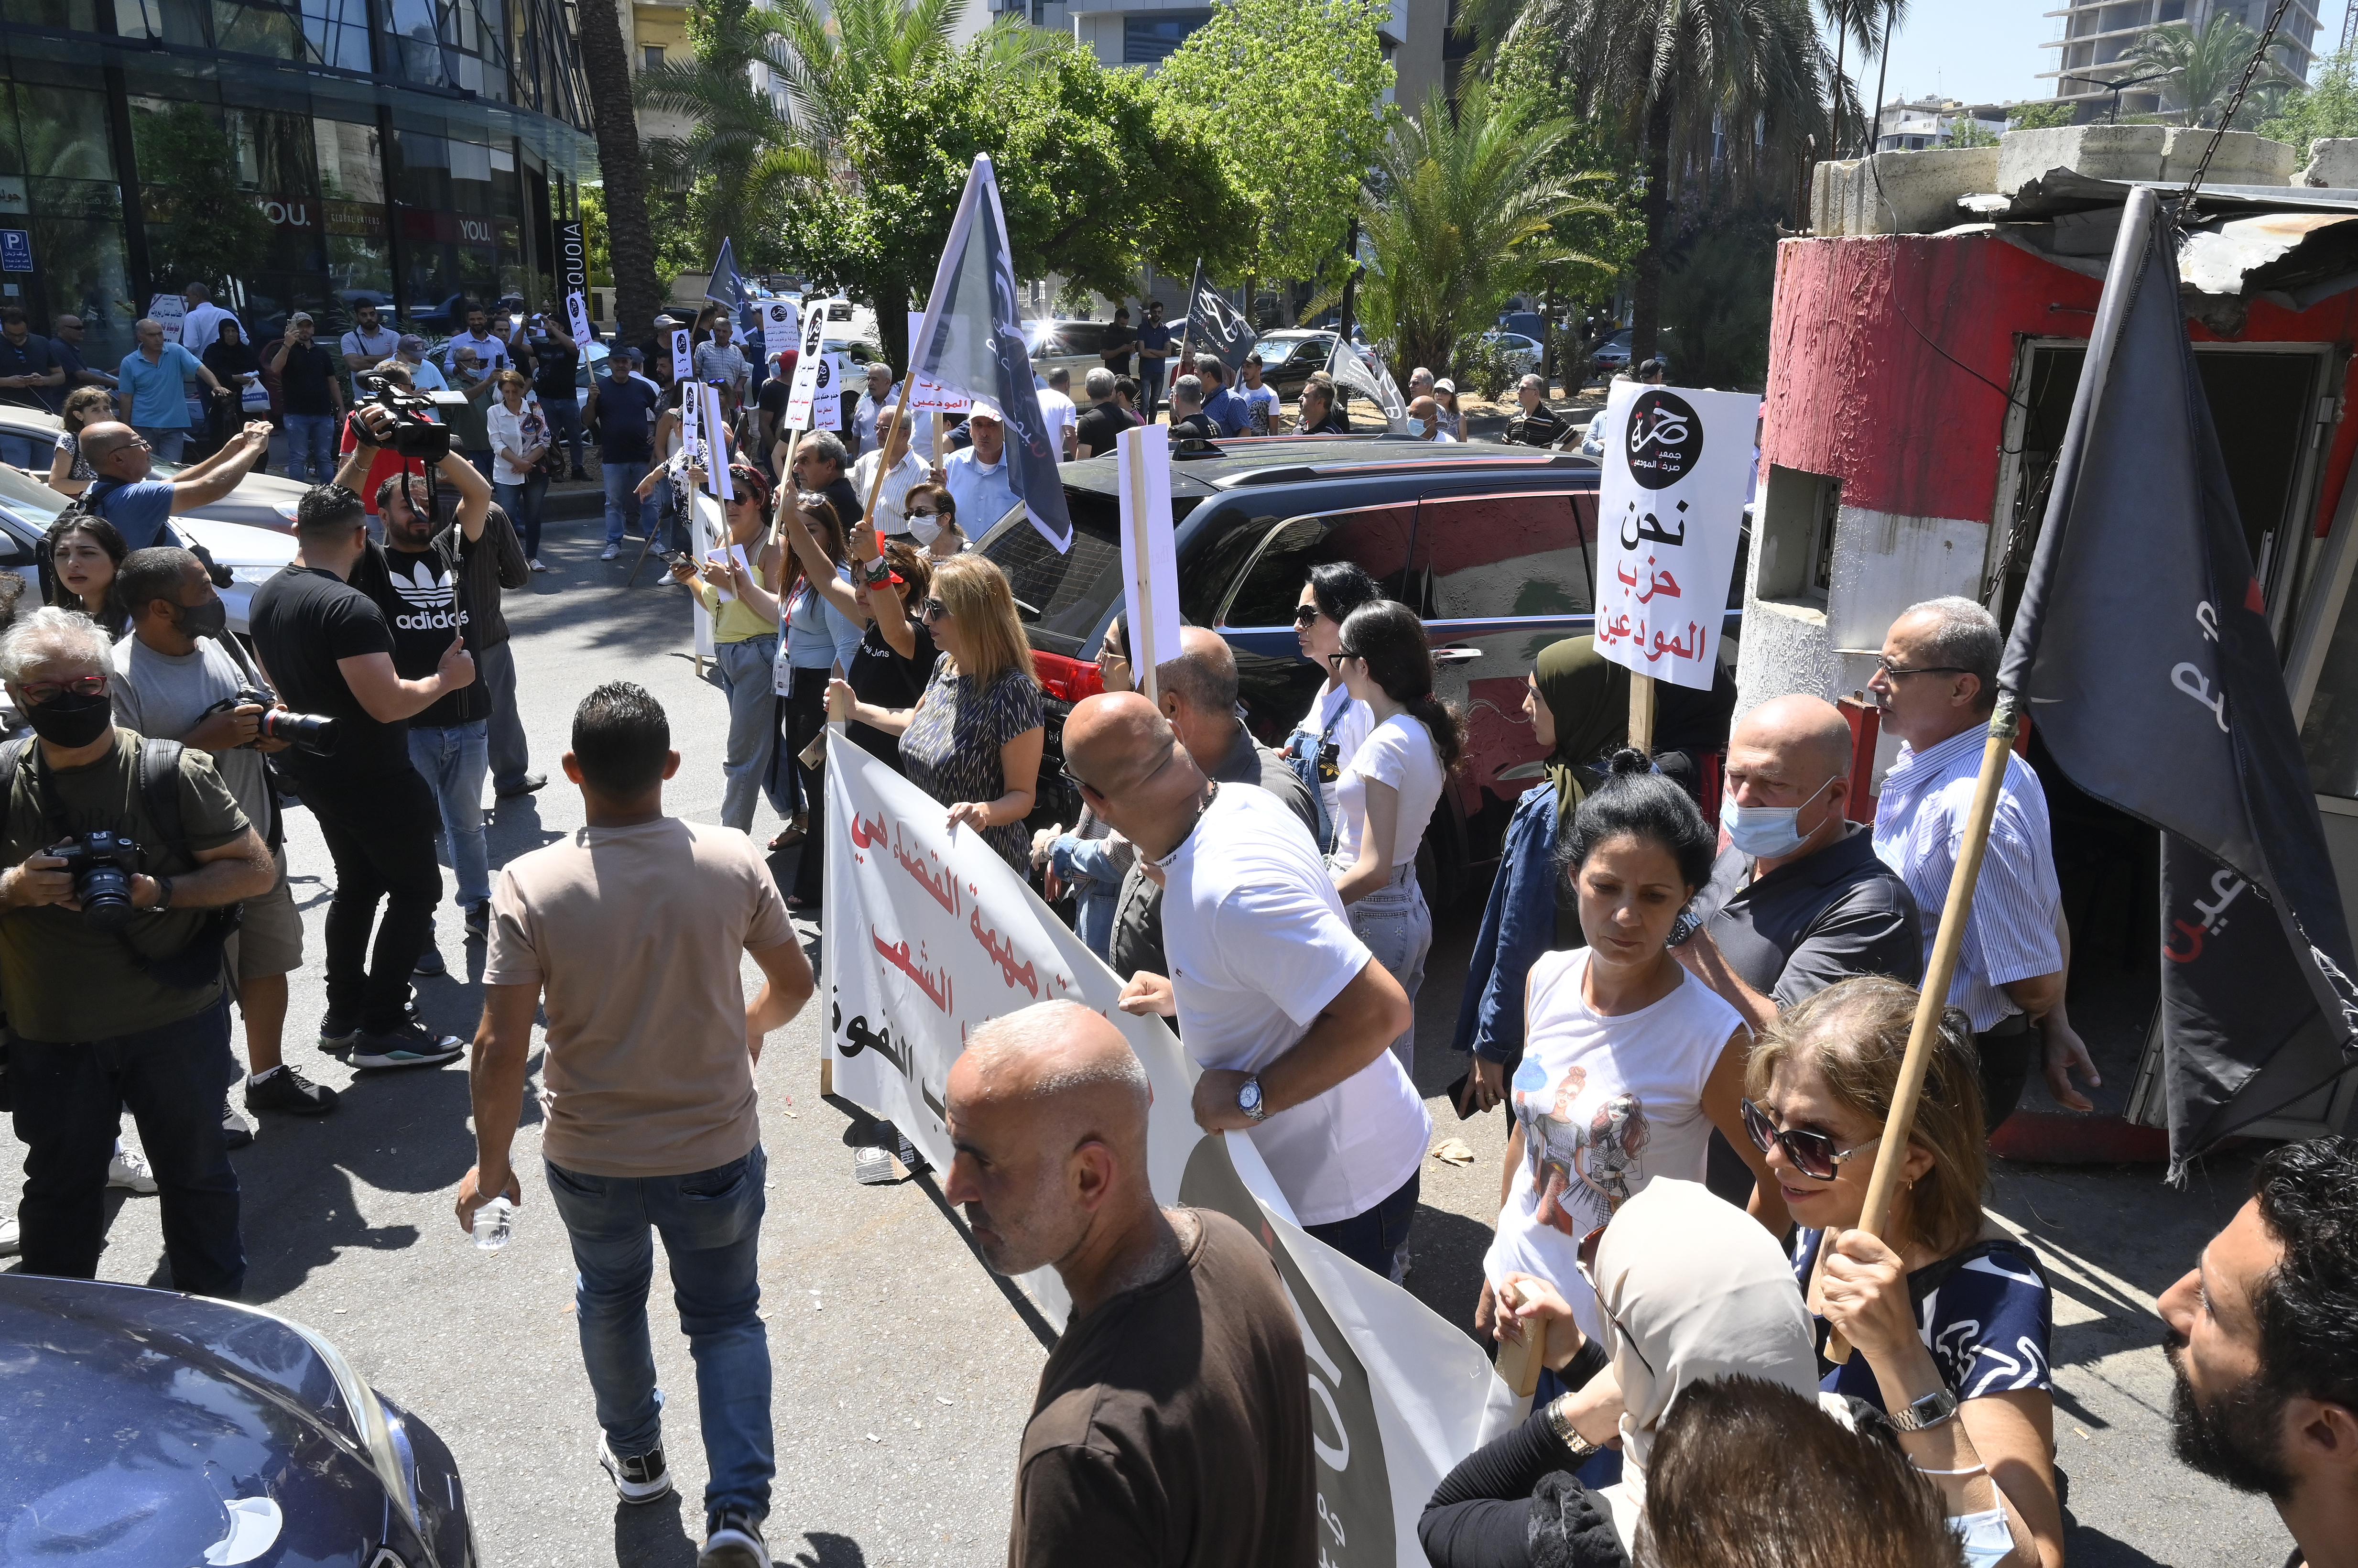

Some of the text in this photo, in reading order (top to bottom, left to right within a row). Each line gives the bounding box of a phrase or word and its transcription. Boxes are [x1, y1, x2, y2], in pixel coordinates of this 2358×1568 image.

[331, 214, 380, 225] GLOBAL EATERS
[459, 219, 490, 241] YOU.
[7, 234, 20, 249] P
[563, 223, 586, 309] EQUOIA
[912, 398, 967, 410] المودعين
[1655, 448, 1682, 461] جمعية
[1658, 461, 1681, 472] صرخة
[427, 466, 435, 497] Panasonic
[1620, 499, 1689, 551] نحن
[1618, 555, 1682, 605] حزب
[395, 610, 470, 631] adidas
[1598, 604, 1706, 664] المودعين
[851, 810, 889, 865] هي
[893, 820, 961, 921] القضاء
[871, 923, 954, 1019] الشعب
[1548, 1134, 1576, 1154] HAS BEEN
[1549, 1126, 1573, 1143] TODAY
[900, 1149, 915, 1165] BEER
